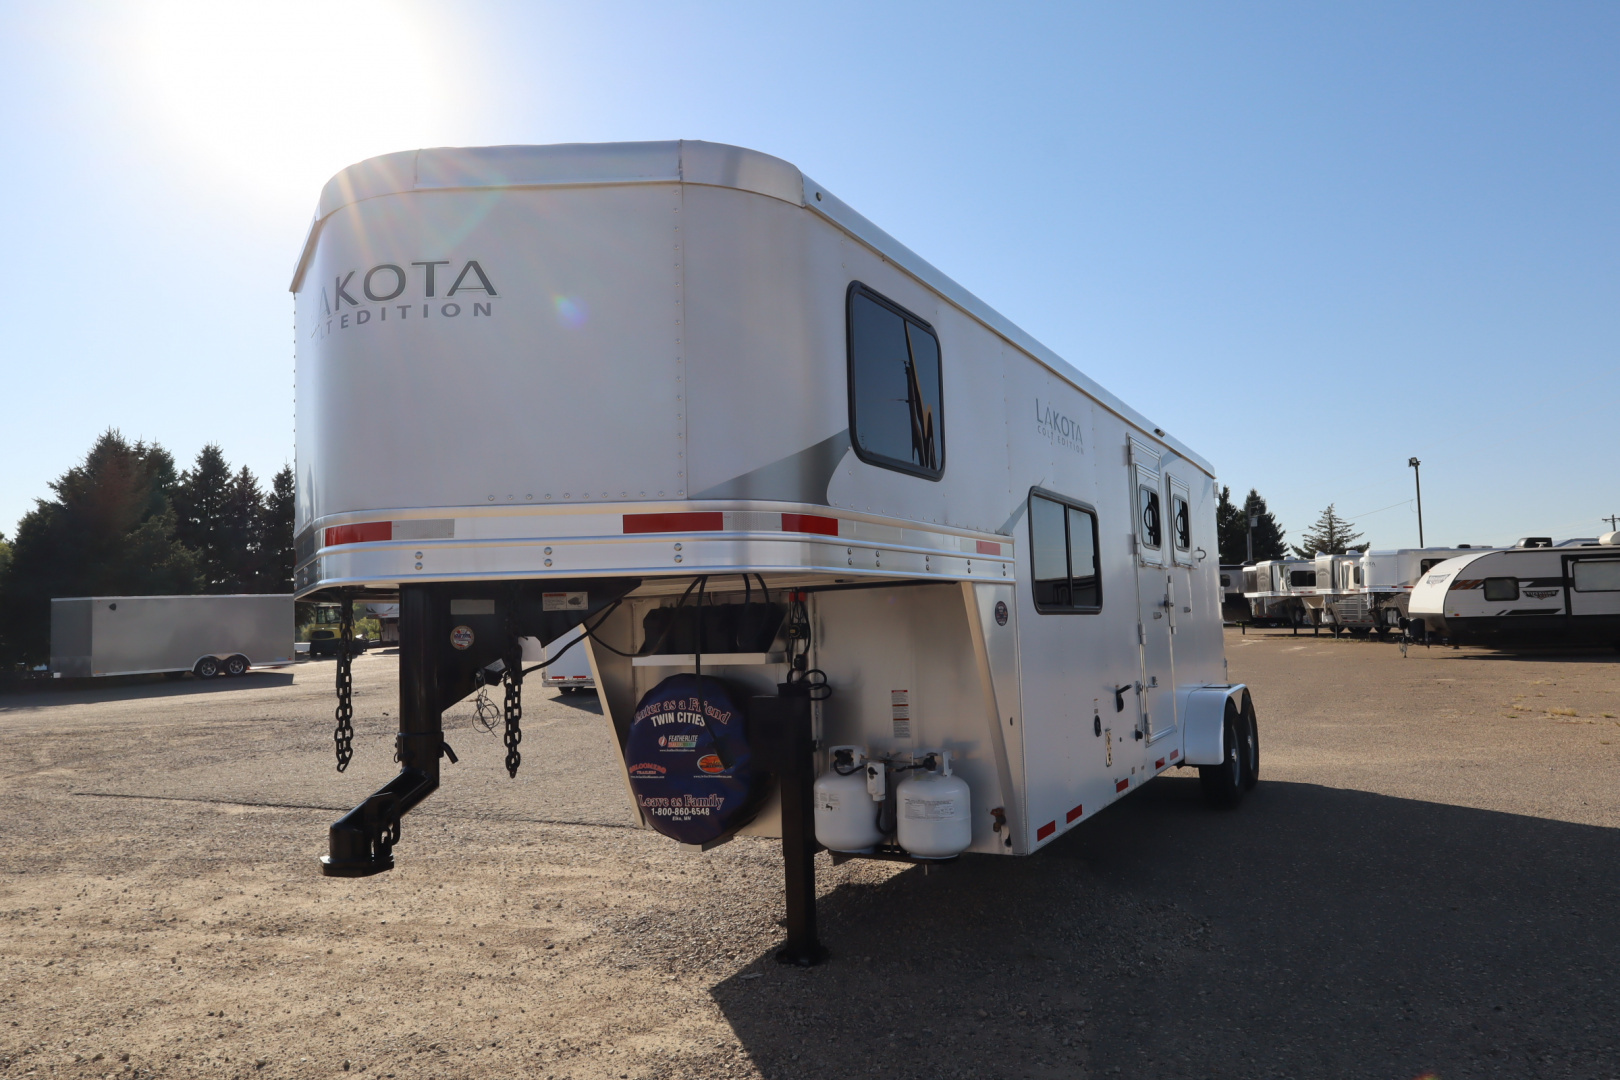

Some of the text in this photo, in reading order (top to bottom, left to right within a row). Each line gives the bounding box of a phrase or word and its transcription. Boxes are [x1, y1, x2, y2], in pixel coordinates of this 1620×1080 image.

[340, 302, 492, 330] EDITION
[1035, 398, 1083, 445] LAKOTA
[663, 700, 677, 711] as
[678, 700, 687, 710] a
[650, 712, 706, 727] TWIN CITIES
[638, 793, 725, 811] Leave as Family
[651, 807, 710, 816] 1-800-860-6548
